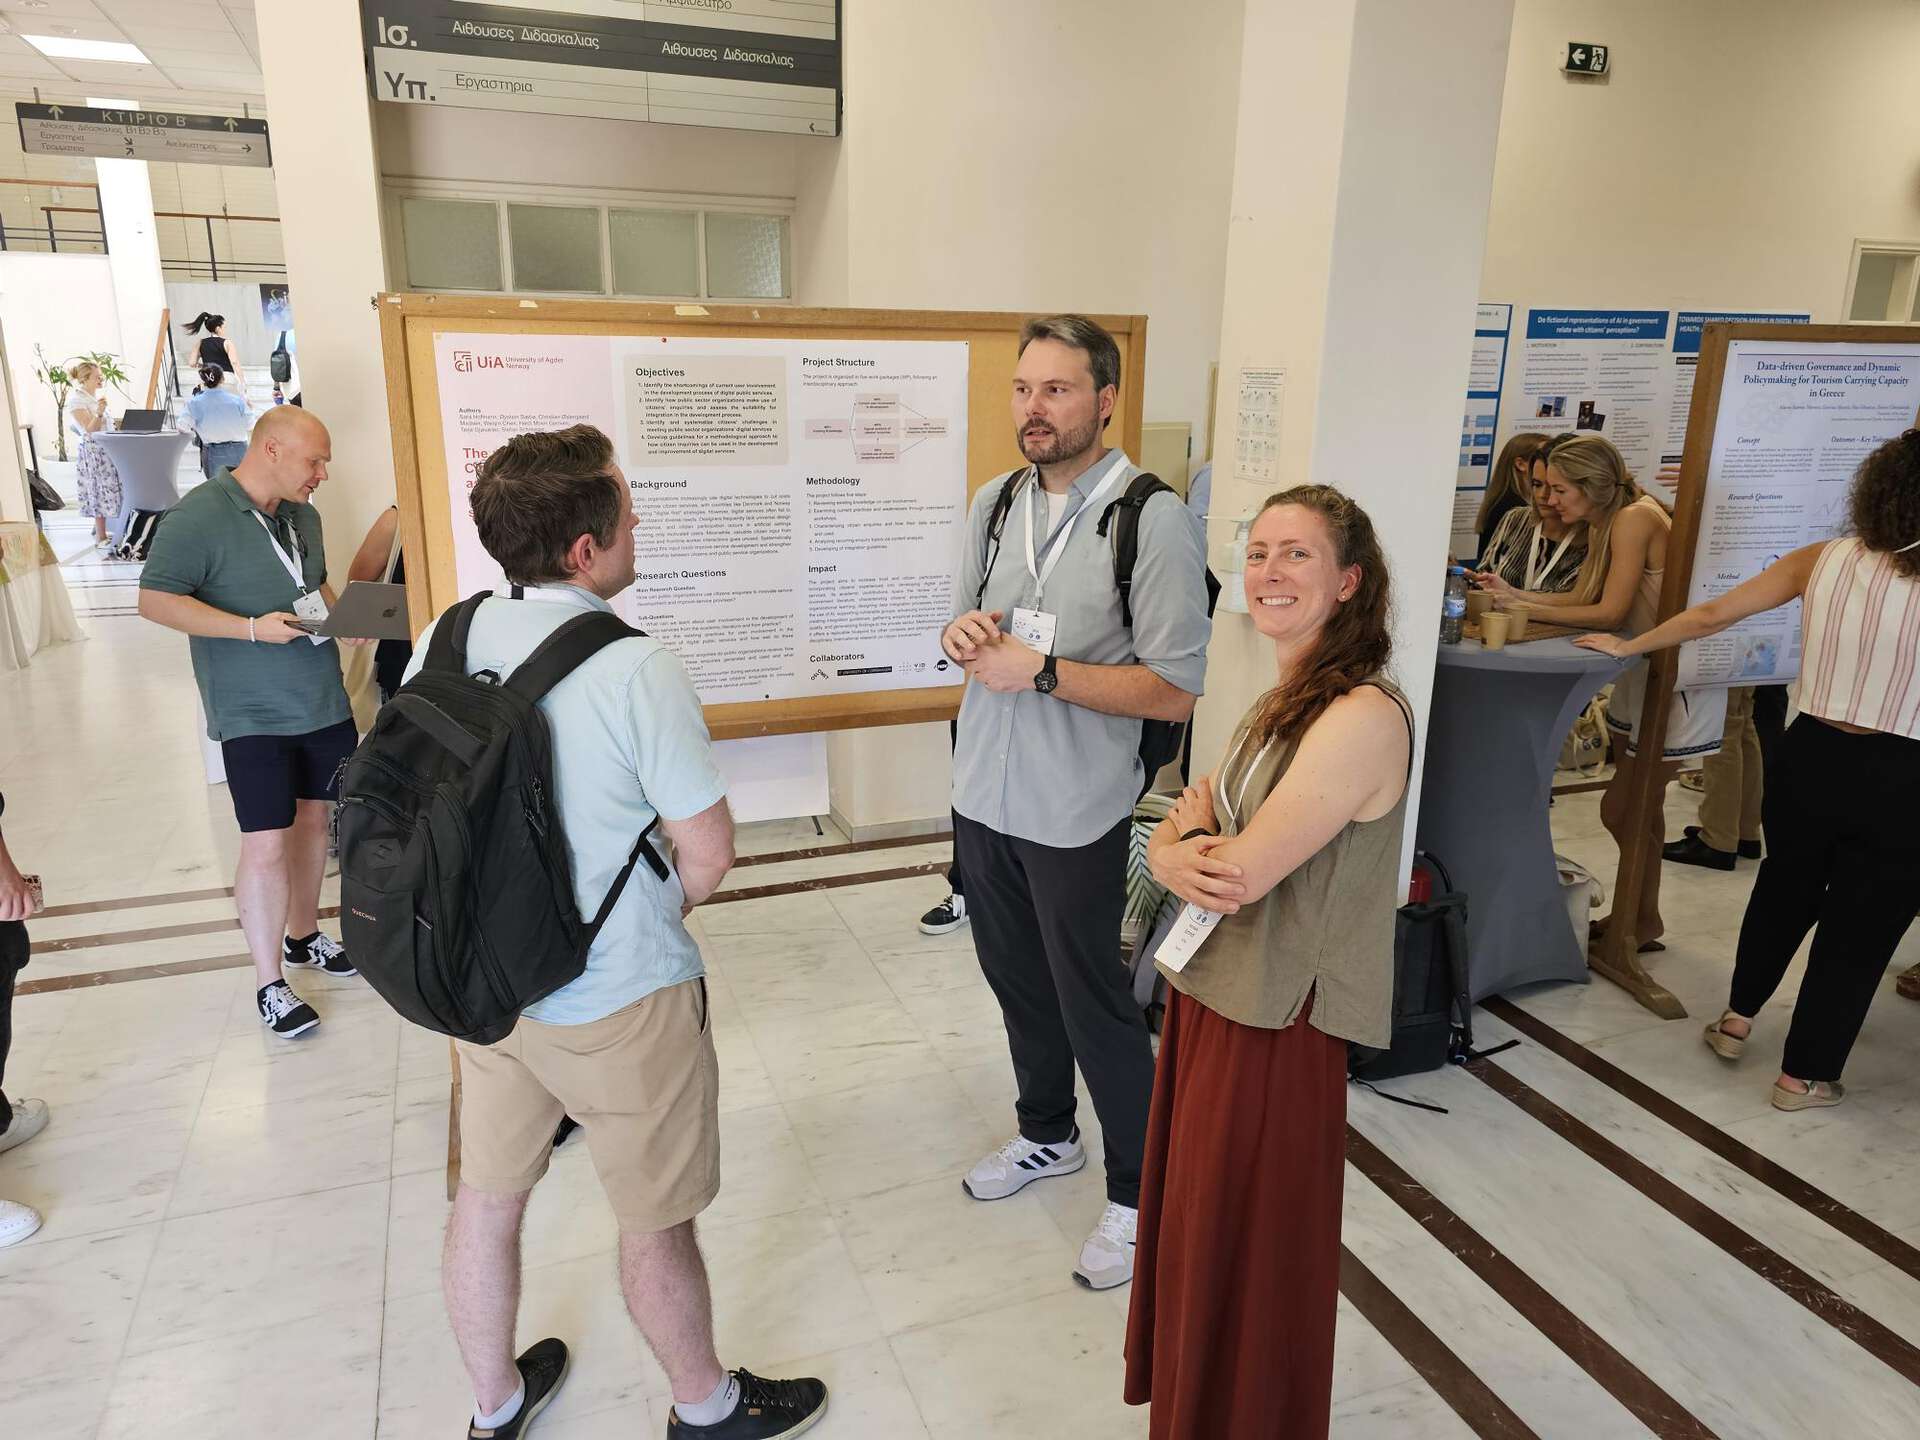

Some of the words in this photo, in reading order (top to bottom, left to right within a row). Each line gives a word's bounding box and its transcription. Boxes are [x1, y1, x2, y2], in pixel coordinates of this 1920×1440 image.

[378, 17, 417, 47] Ισ.
[452, 20, 514, 41] Αιθουσες
[521, 27, 599, 50] Διδασκαλιας
[661, 40, 717, 61] Αιθουσες
[723, 47, 794, 68] Διδασκαλιας
[384, 70, 435, 101] Υπ.
[455, 73, 533, 94] Εργαστηρια
[1569, 317, 1608, 325] representations
[477, 356, 504, 369] UiA
[802, 358, 834, 368] Project
[836, 358, 875, 366] Structure
[1756, 360, 1805, 371] Data-driven
[1806, 362, 1851, 371] Governance
[1853, 362, 1867, 371] and
[1868, 362, 1901, 374] Dynamic
[635, 368, 686, 378] Objectives
[1743, 374, 1796, 386] Policymaking
[1798, 374, 1809, 386] for
[1811, 375, 1843, 384] Tourism
[1844, 376, 1877, 387] Carrying
[1878, 376, 1909, 387] Capacity
[1809, 389, 1818, 397] in
[1819, 389, 1846, 398] Greece
[464, 448, 488, 458] The
[630, 480, 687, 490] Background
[806, 477, 860, 486] Methodology
[1755, 493, 1783, 501] Questions
[808, 565, 836, 574] Impact
[636, 570, 678, 580] Research
[681, 570, 726, 578] Questions
[810, 653, 865, 663] Collaborators
